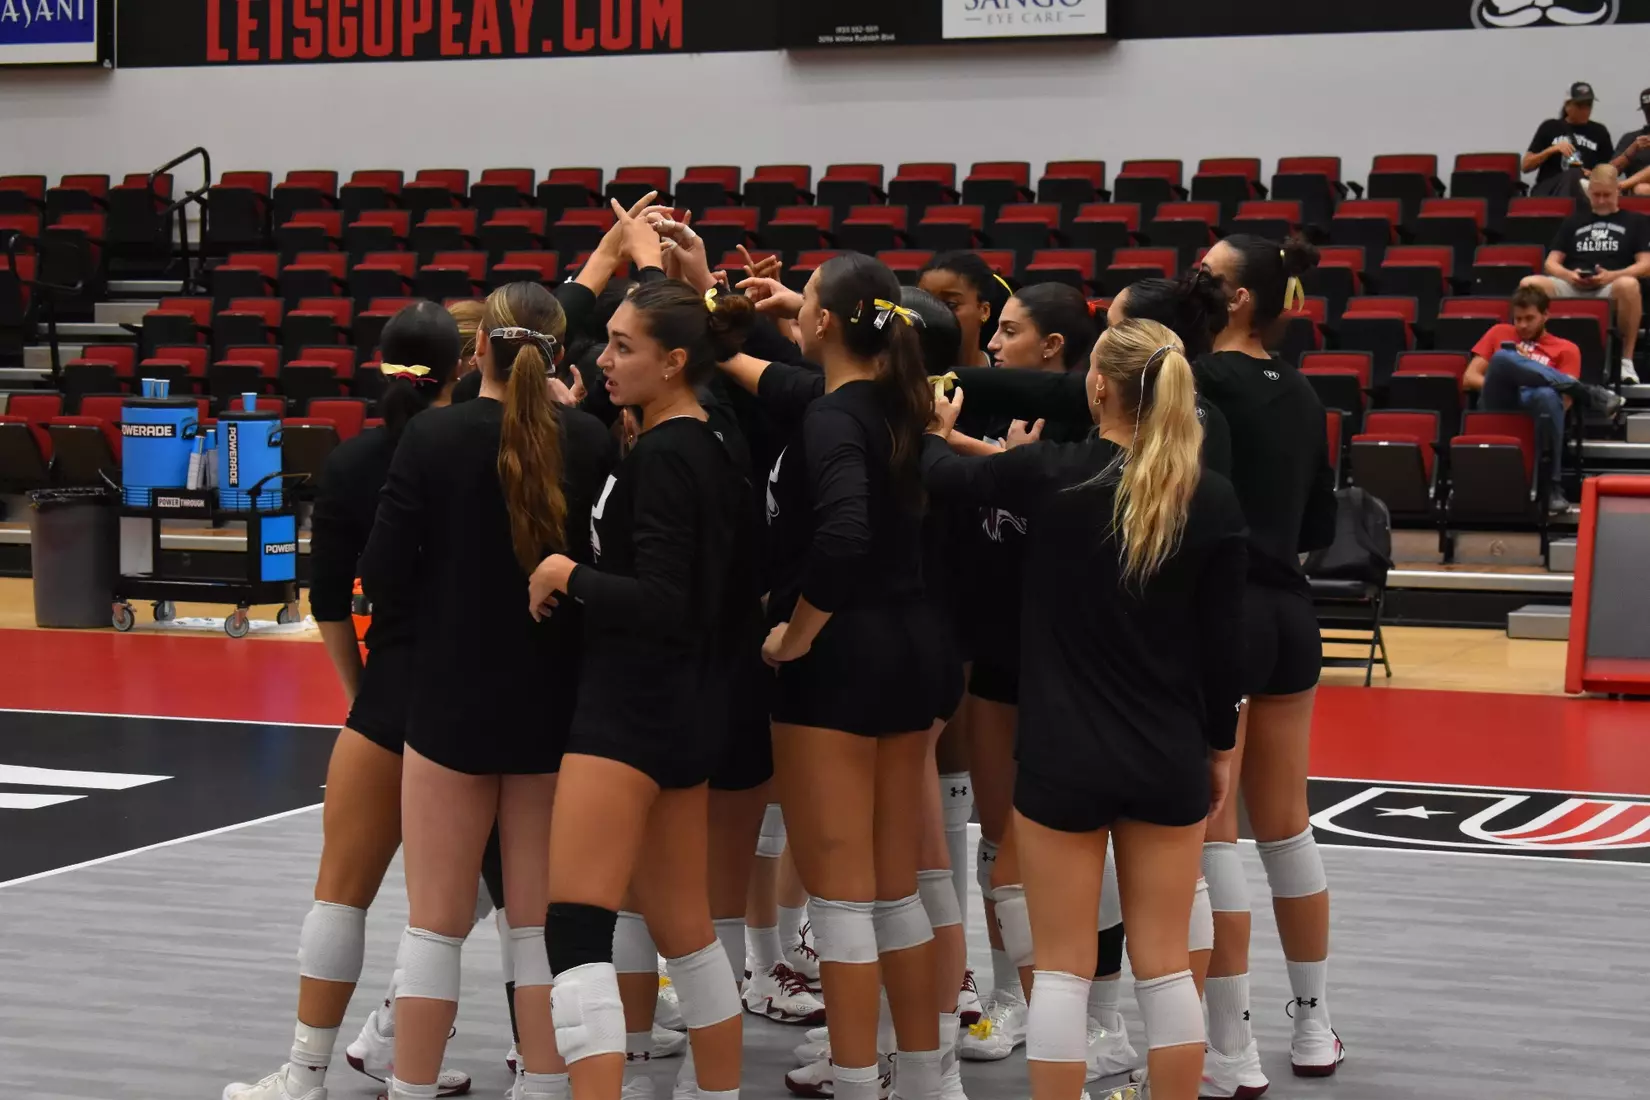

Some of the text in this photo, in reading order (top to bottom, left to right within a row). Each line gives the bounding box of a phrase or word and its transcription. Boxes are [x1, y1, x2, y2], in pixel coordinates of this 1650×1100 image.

[987, 11, 1064, 25] EYE CARE
[1576, 240, 1619, 252] SALUKIS
[229, 426, 238, 485] POWERADE
